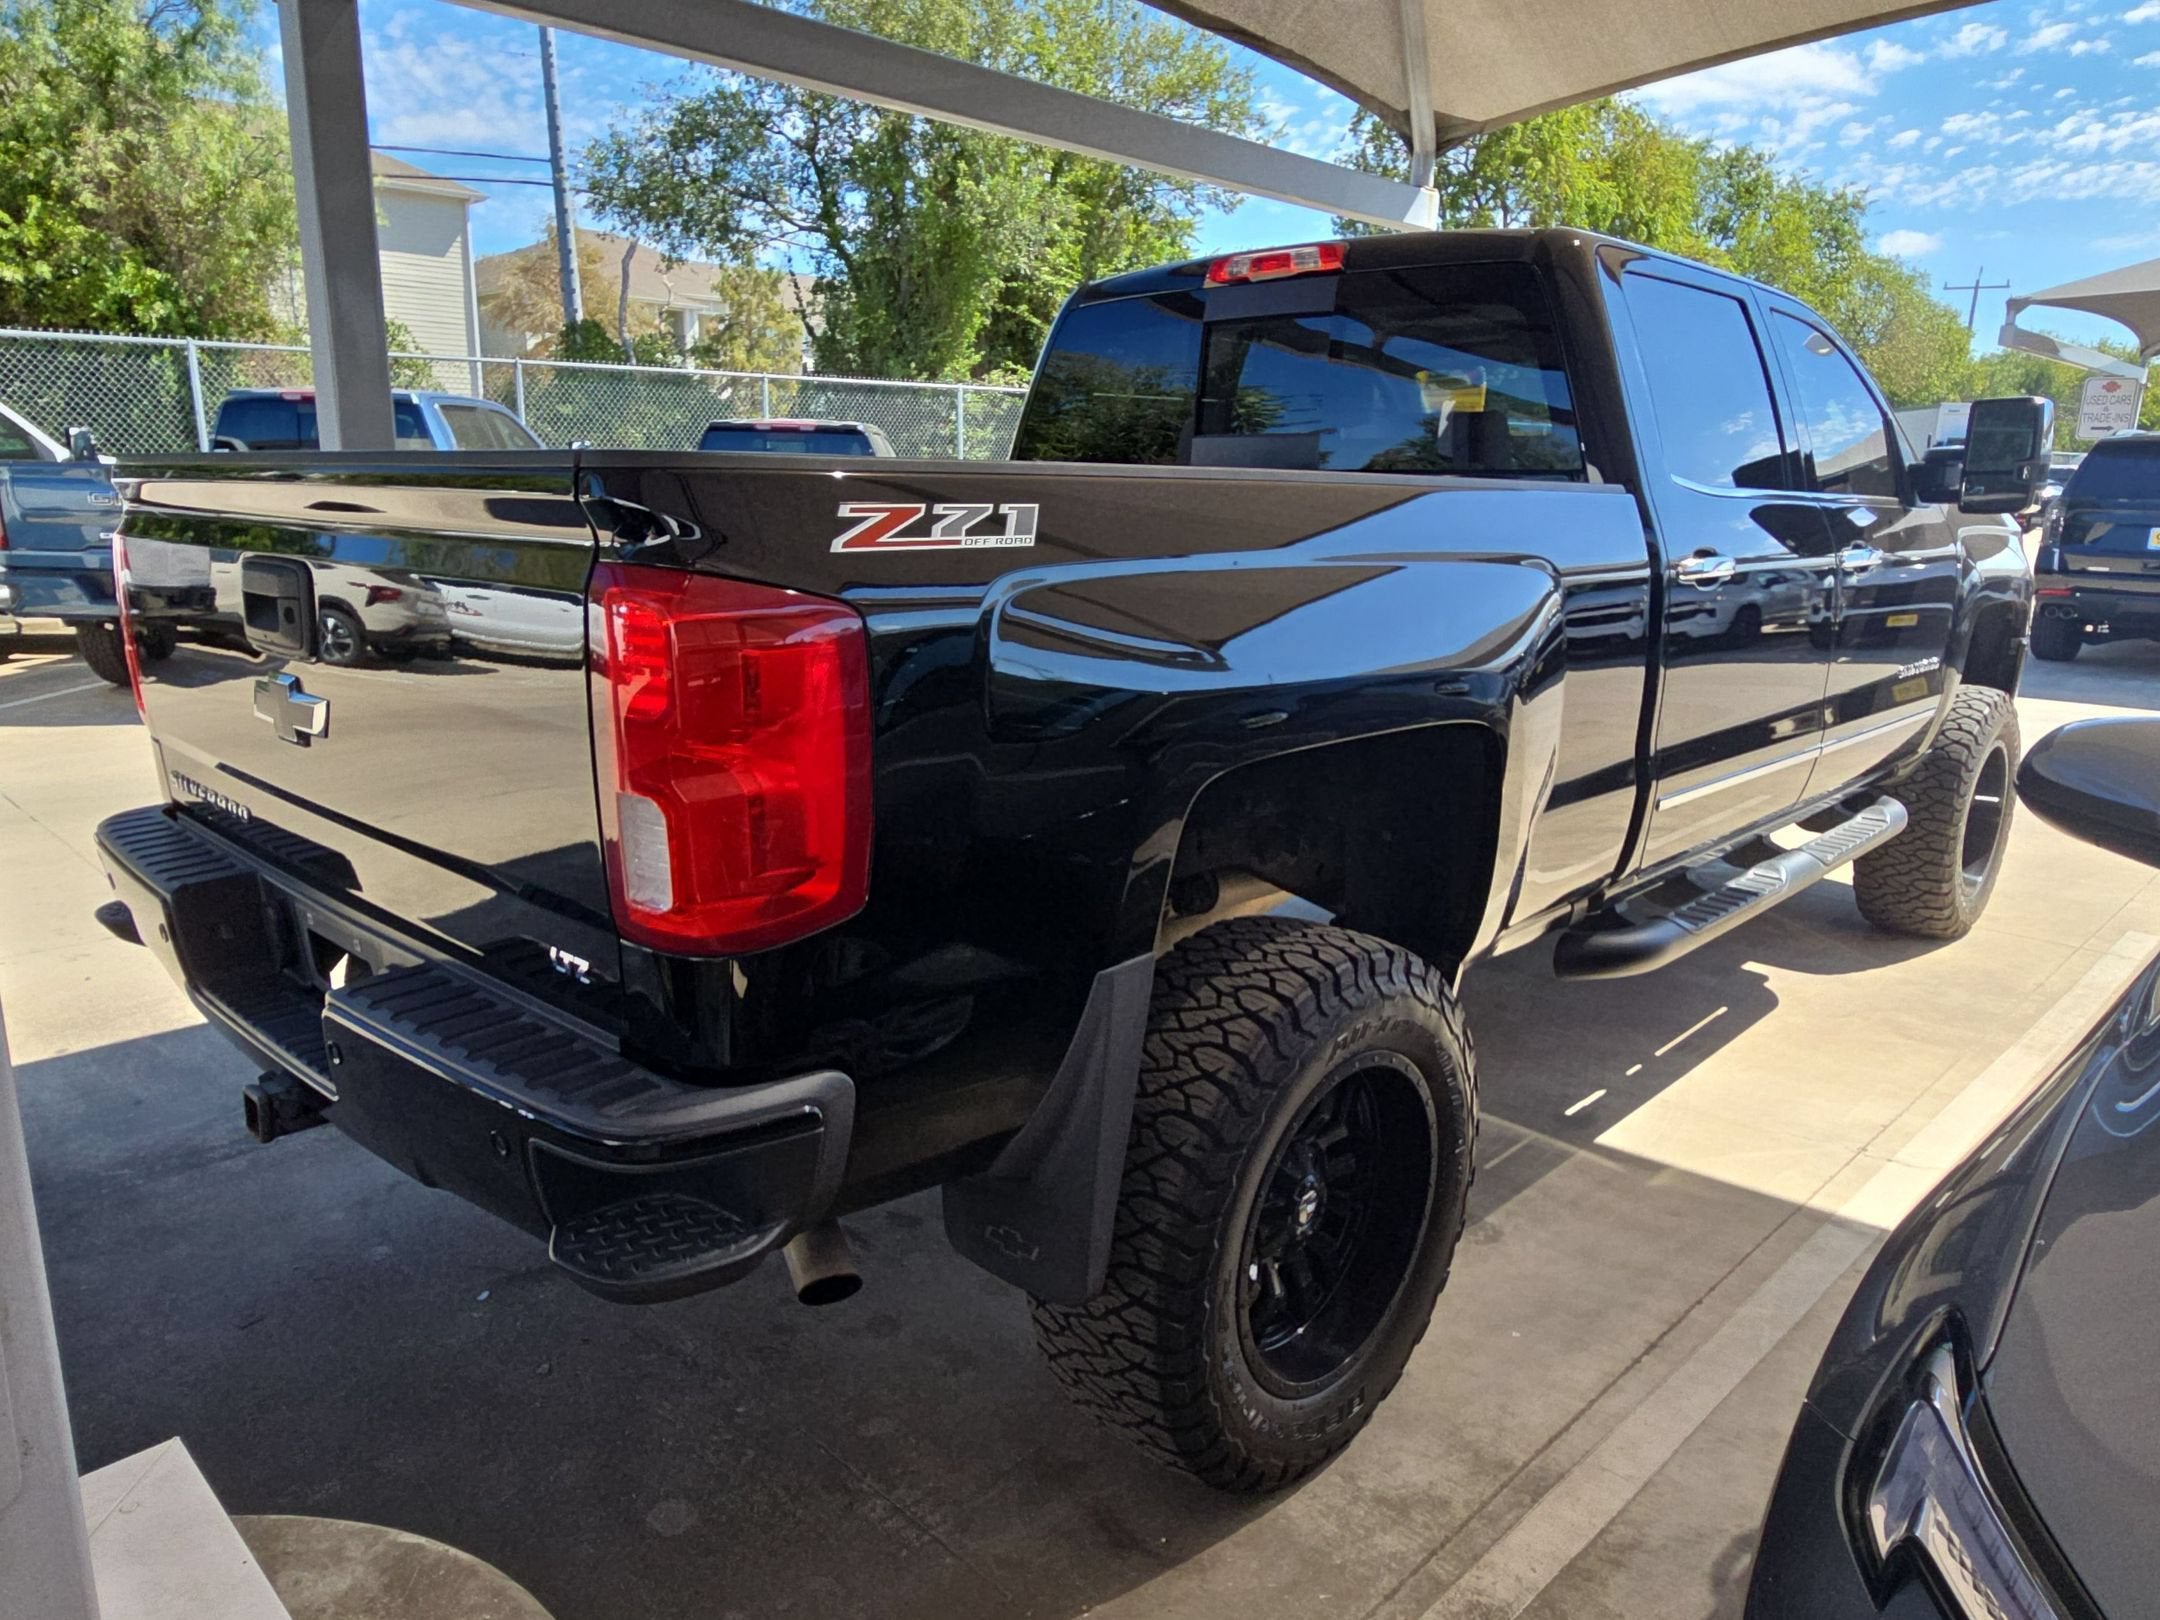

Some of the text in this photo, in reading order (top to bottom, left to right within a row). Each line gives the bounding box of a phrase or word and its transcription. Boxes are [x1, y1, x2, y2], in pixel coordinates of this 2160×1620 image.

[2087, 395, 2132, 405] USED CARS
[830, 503, 1039, 552] Z71
[964, 536, 1033, 546] OFF ROAD
[550, 946, 590, 984] LTZ
